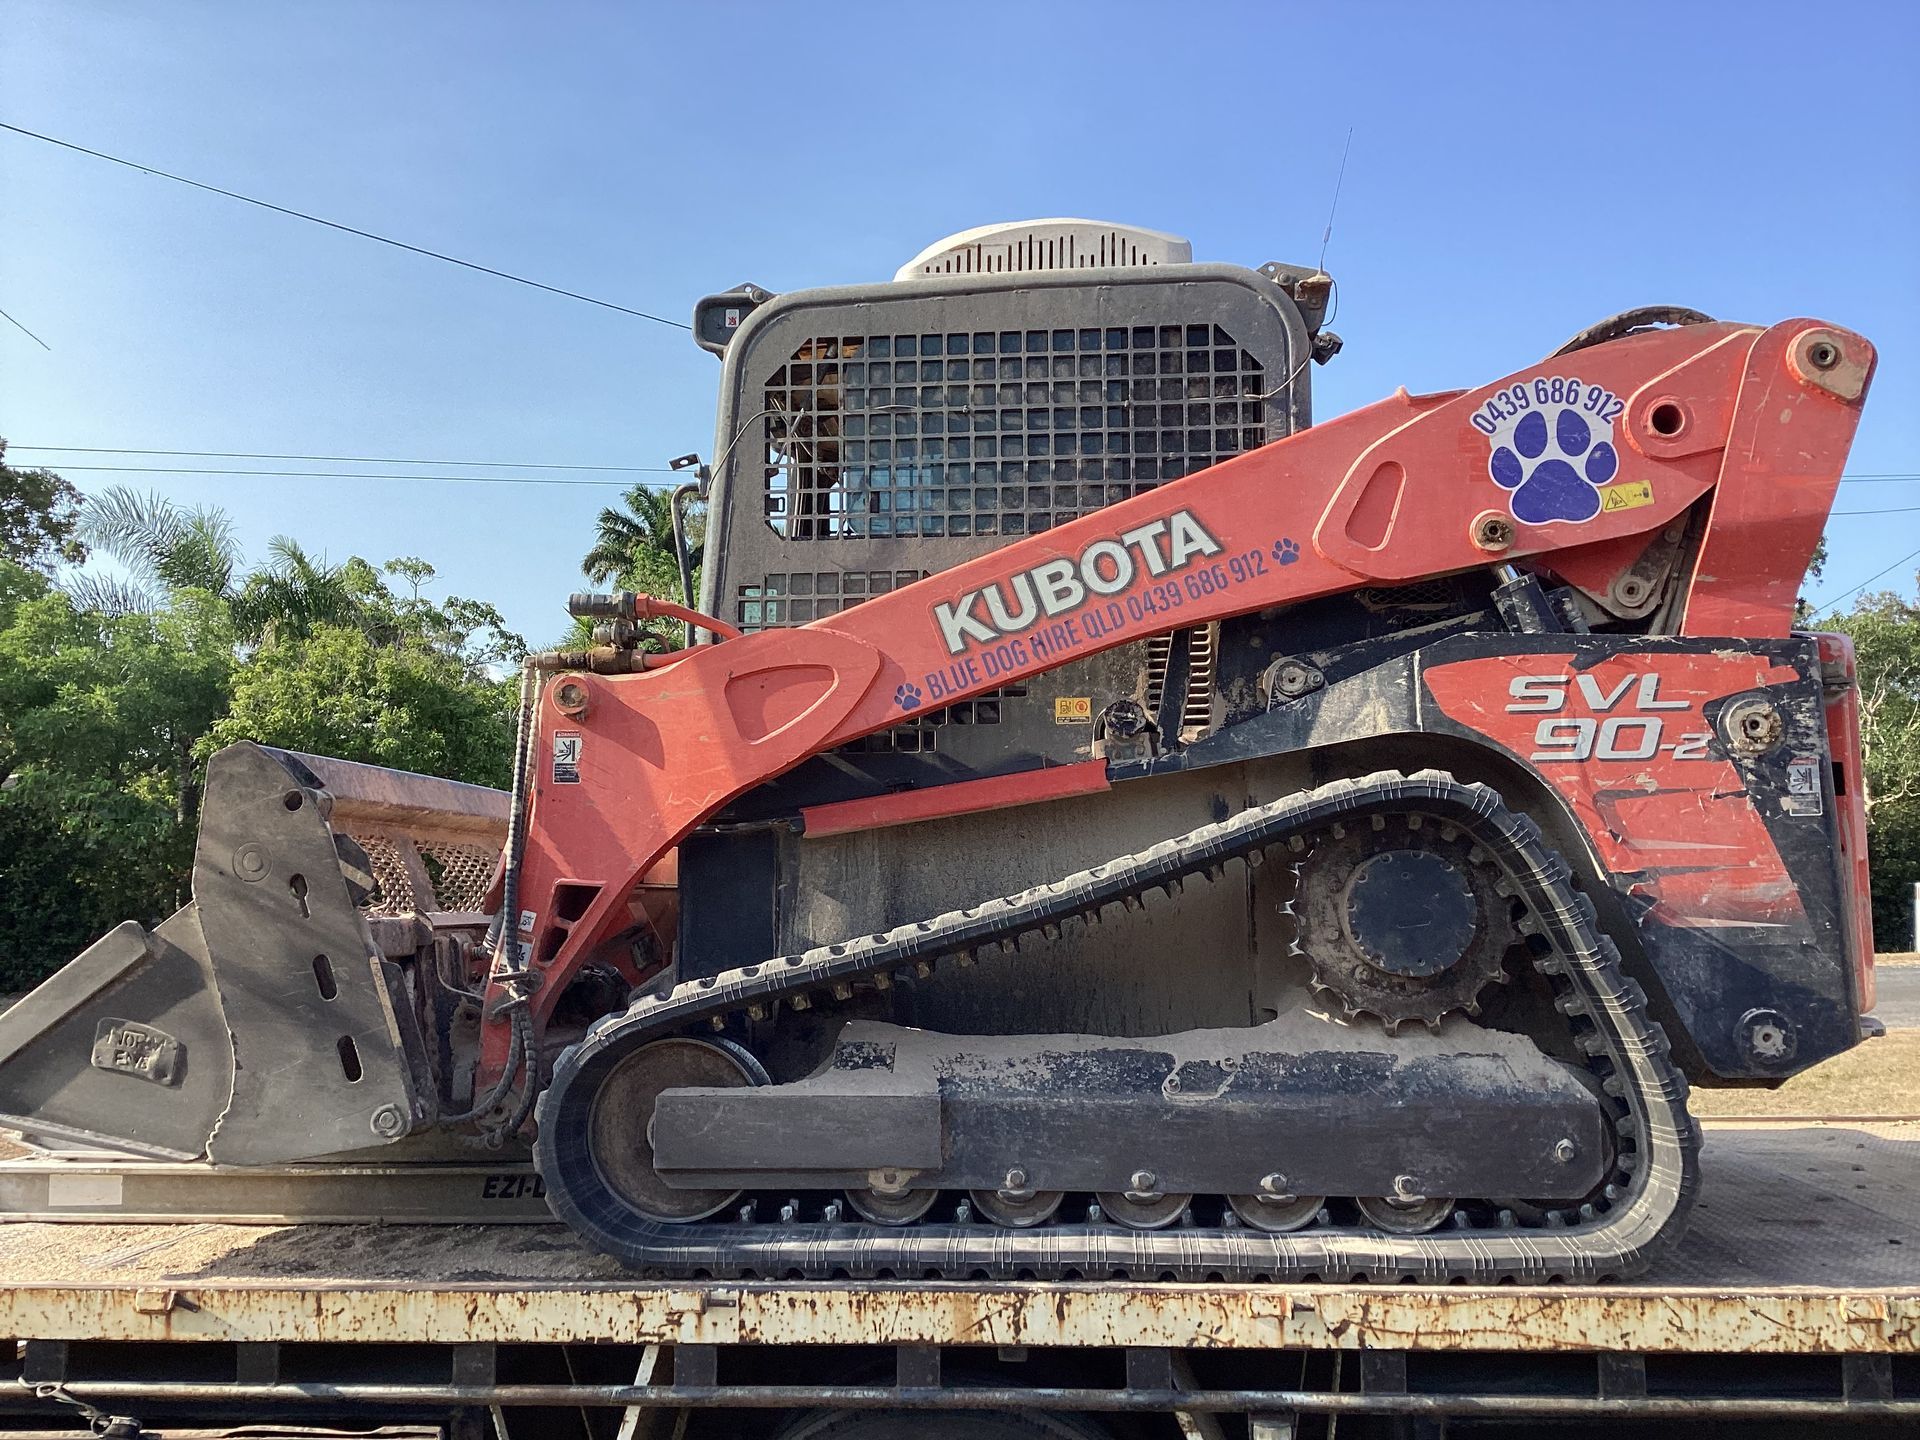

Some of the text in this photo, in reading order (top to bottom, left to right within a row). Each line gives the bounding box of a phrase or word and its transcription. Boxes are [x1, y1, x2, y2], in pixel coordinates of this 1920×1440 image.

[1472, 378, 1625, 434] 0439 686 912
[934, 510, 1221, 654] KUBOTA
[925, 549, 1269, 700] BLUE DOG HIRE QLD 0439 686 912
[1505, 673, 1690, 714] SVL
[1530, 717, 1713, 760] 90-2
